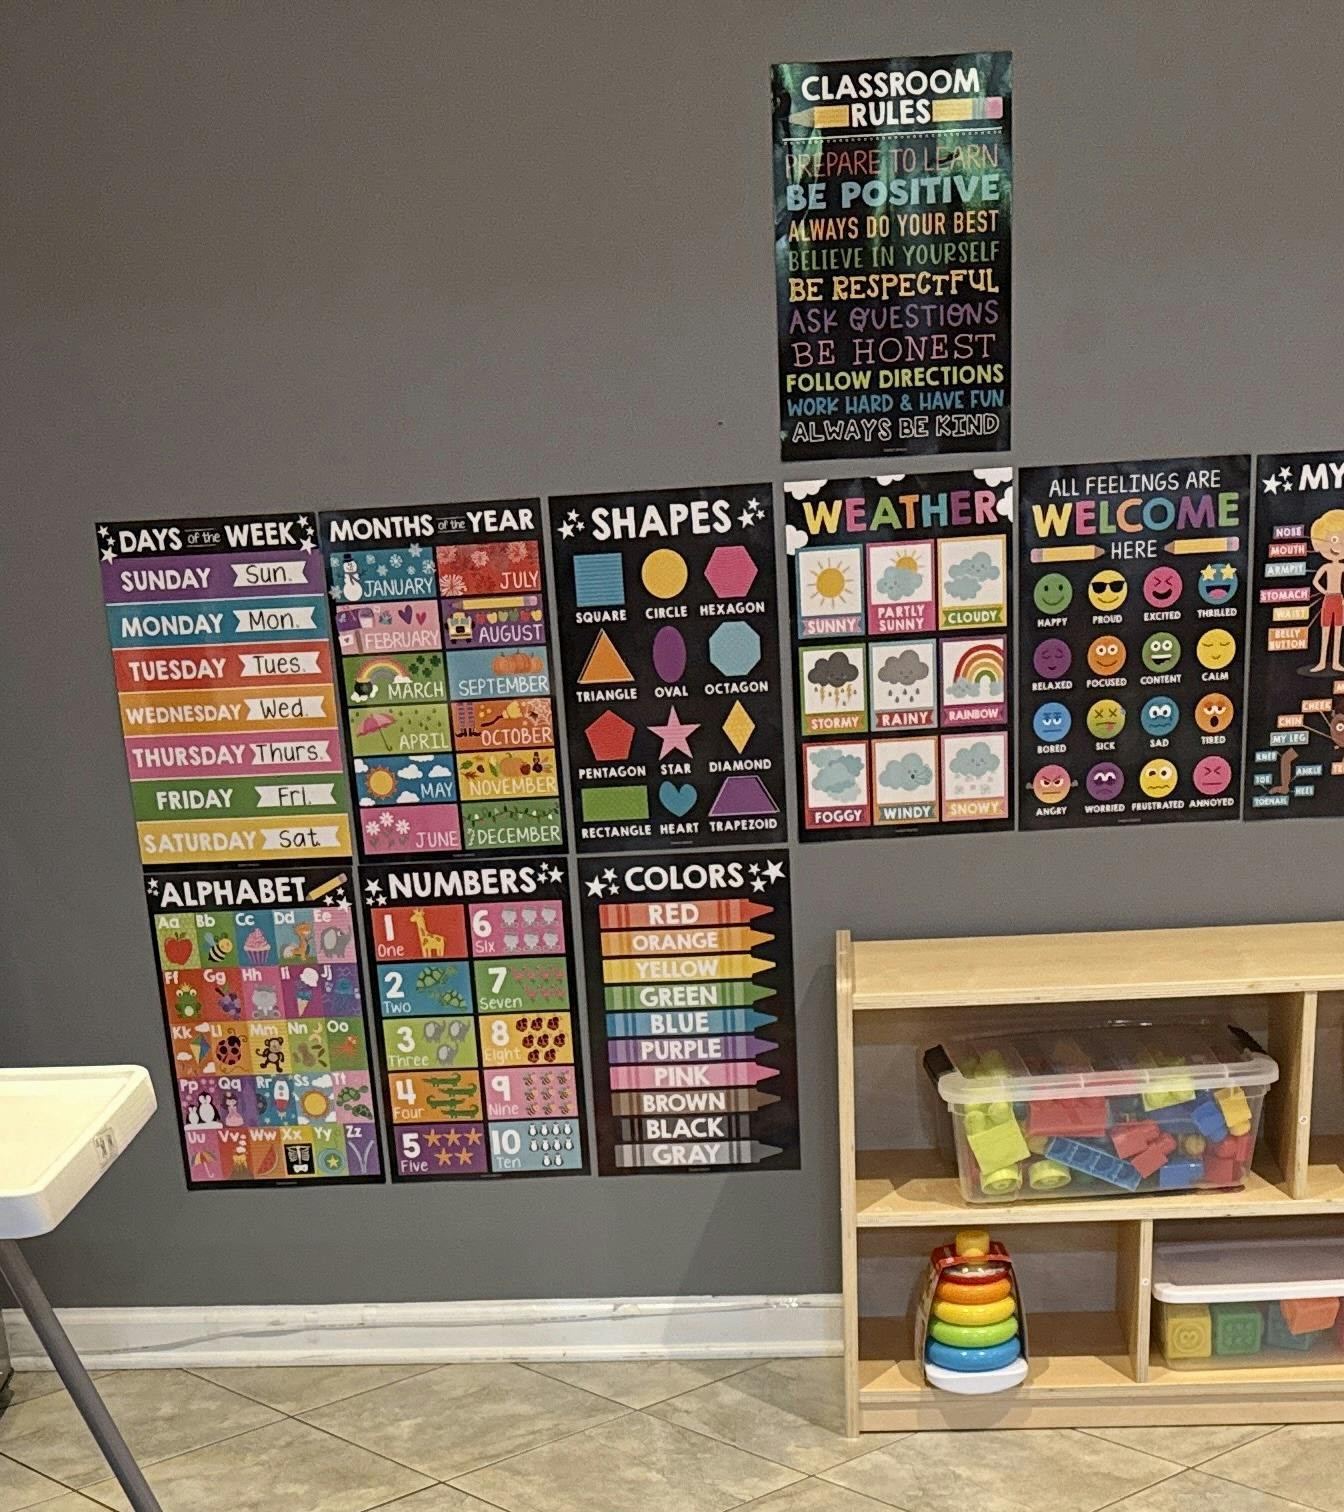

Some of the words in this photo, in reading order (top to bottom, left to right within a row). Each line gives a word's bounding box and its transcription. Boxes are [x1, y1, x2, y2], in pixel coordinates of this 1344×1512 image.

[801, 67, 980, 103] CLASSROOM
[849, 99, 931, 127] RULES
[785, 148, 880, 179] PREPARE
[892, 149, 916, 174] TO
[924, 143, 999, 172] LEARN
[787, 183, 828, 212] BE
[841, 174, 1000, 209] POSITIVE
[789, 216, 859, 242] ALWAYS
[866, 219, 890, 238] DO
[898, 214, 945, 236] YOUR
[954, 209, 999, 233] BEST
[789, 247, 863, 271] BELIEVE
[872, 248, 895, 268] IN
[903, 240, 1000, 265] YOURSELF
[789, 278, 823, 302] BE
[832, 268, 1000, 300] RESPECTFUL
[789, 308, 838, 334] ASK
[849, 300, 999, 332] QUESTIONS
[791, 340, 836, 368] BE
[852, 333, 996, 365] HONEST
[786, 369, 871, 392] FOLLOW
[879, 364, 1004, 388] DIRECTIONS
[787, 397, 838, 417] WORK
[844, 394, 892, 414] HARD
[901, 394, 910, 410] &
[918, 392, 964, 411] HAVE
[970, 389, 1004, 407] FUN
[792, 415, 890, 443] ALWAYS
[898, 416, 929, 439] BE
[935, 413, 1000, 438] KIND
[1049, 479, 1080, 498] ALL
[1086, 473, 1180, 495] FEELINGS
[1186, 470, 1221, 489] ARE
[591, 499, 732, 541] SHAPES
[803, 490, 998, 535] WEATHER
[1032, 492, 1239, 538] WELCOME
[330, 514, 434, 542] MONTHS
[438, 520, 448, 530] of
[450, 519, 465, 530] the
[466, 509, 534, 533] YEAR
[119, 527, 183, 553] DAYS
[187, 533, 200, 544] of
[203, 531, 220, 543] the
[224, 522, 296, 547] WEEK
[1111, 540, 1158, 560] HERE
[120, 568, 210, 592] SUNDAY
[246, 564, 293, 584] Sun.
[364, 577, 434, 598] JANUARY
[500, 572, 539, 590] JULY
[576, 609, 627, 624] SQUARE
[645, 606, 688, 619] CIRCLE
[700, 601, 765, 616] HEXAGON
[878, 604, 925, 619] PARTLY
[947, 610, 998, 624] CLOUDY
[122, 614, 223, 638] MONDAY
[249, 611, 300, 630] Mon.
[479, 624, 543, 643] AUGUST
[808, 618, 857, 634] SUNNY
[879, 618, 924, 631] SUNNY
[365, 630, 440, 649] FEBRUARY
[129, 658, 226, 682] TUESDAY
[254, 655, 306, 674] Tues.
[1202, 672, 1229, 681] CALM
[388, 682, 444, 699] MARCH
[458, 676, 549, 696] SEPTEMBER
[576, 688, 637, 703] TRIANGLE
[654, 686, 689, 698] OVAL
[704, 681, 769, 695] OCTAGON
[125, 704, 242, 725] WEDNESDAY
[811, 717, 859, 730] STORMY
[882, 712, 928, 726] RAINY
[949, 709, 998, 721] RAINBOW
[400, 732, 449, 750] APRIL
[481, 727, 553, 746] OCTOBER
[132, 744, 245, 768] THURSDAY
[709, 759, 772, 773] DIAMOND
[579, 766, 647, 779] PENTAGON
[660, 764, 692, 775] STAR
[420, 783, 454, 798] MAY
[469, 777, 557, 796] NOVEMBER
[156, 789, 233, 810] FRIDAY
[950, 801, 999, 816] SNOWY
[815, 809, 862, 823] FOGGY
[884, 806, 931, 819] WINDY
[478, 826, 560, 844] DECEMBER
[581, 824, 652, 839] RECTANGLE
[660, 822, 699, 834] HEART
[710, 818, 778, 832] TRAPEZOID
[144, 831, 256, 854] SATURDAY
[416, 832, 459, 849] JUNE
[389, 867, 537, 899] NUMBERS
[625, 862, 744, 892] COLORS
[161, 877, 306, 908] ALPHABET
[648, 903, 699, 925] RED
[378, 944, 405, 957] One
[632, 932, 718, 951] ORANGE
[636, 960, 718, 978] YELLOW
[479, 997, 522, 1010] Seven
[640, 986, 718, 1007] GREEN
[384, 1003, 411, 1013] Two
[651, 1012, 709, 1034] BLUE
[641, 1038, 722, 1060] PURPLE
[655, 1066, 711, 1087] PINK
[643, 1093, 726, 1113] BROWN
[646, 1117, 724, 1139] BLACK
[652, 1144, 721, 1165] GRAY
